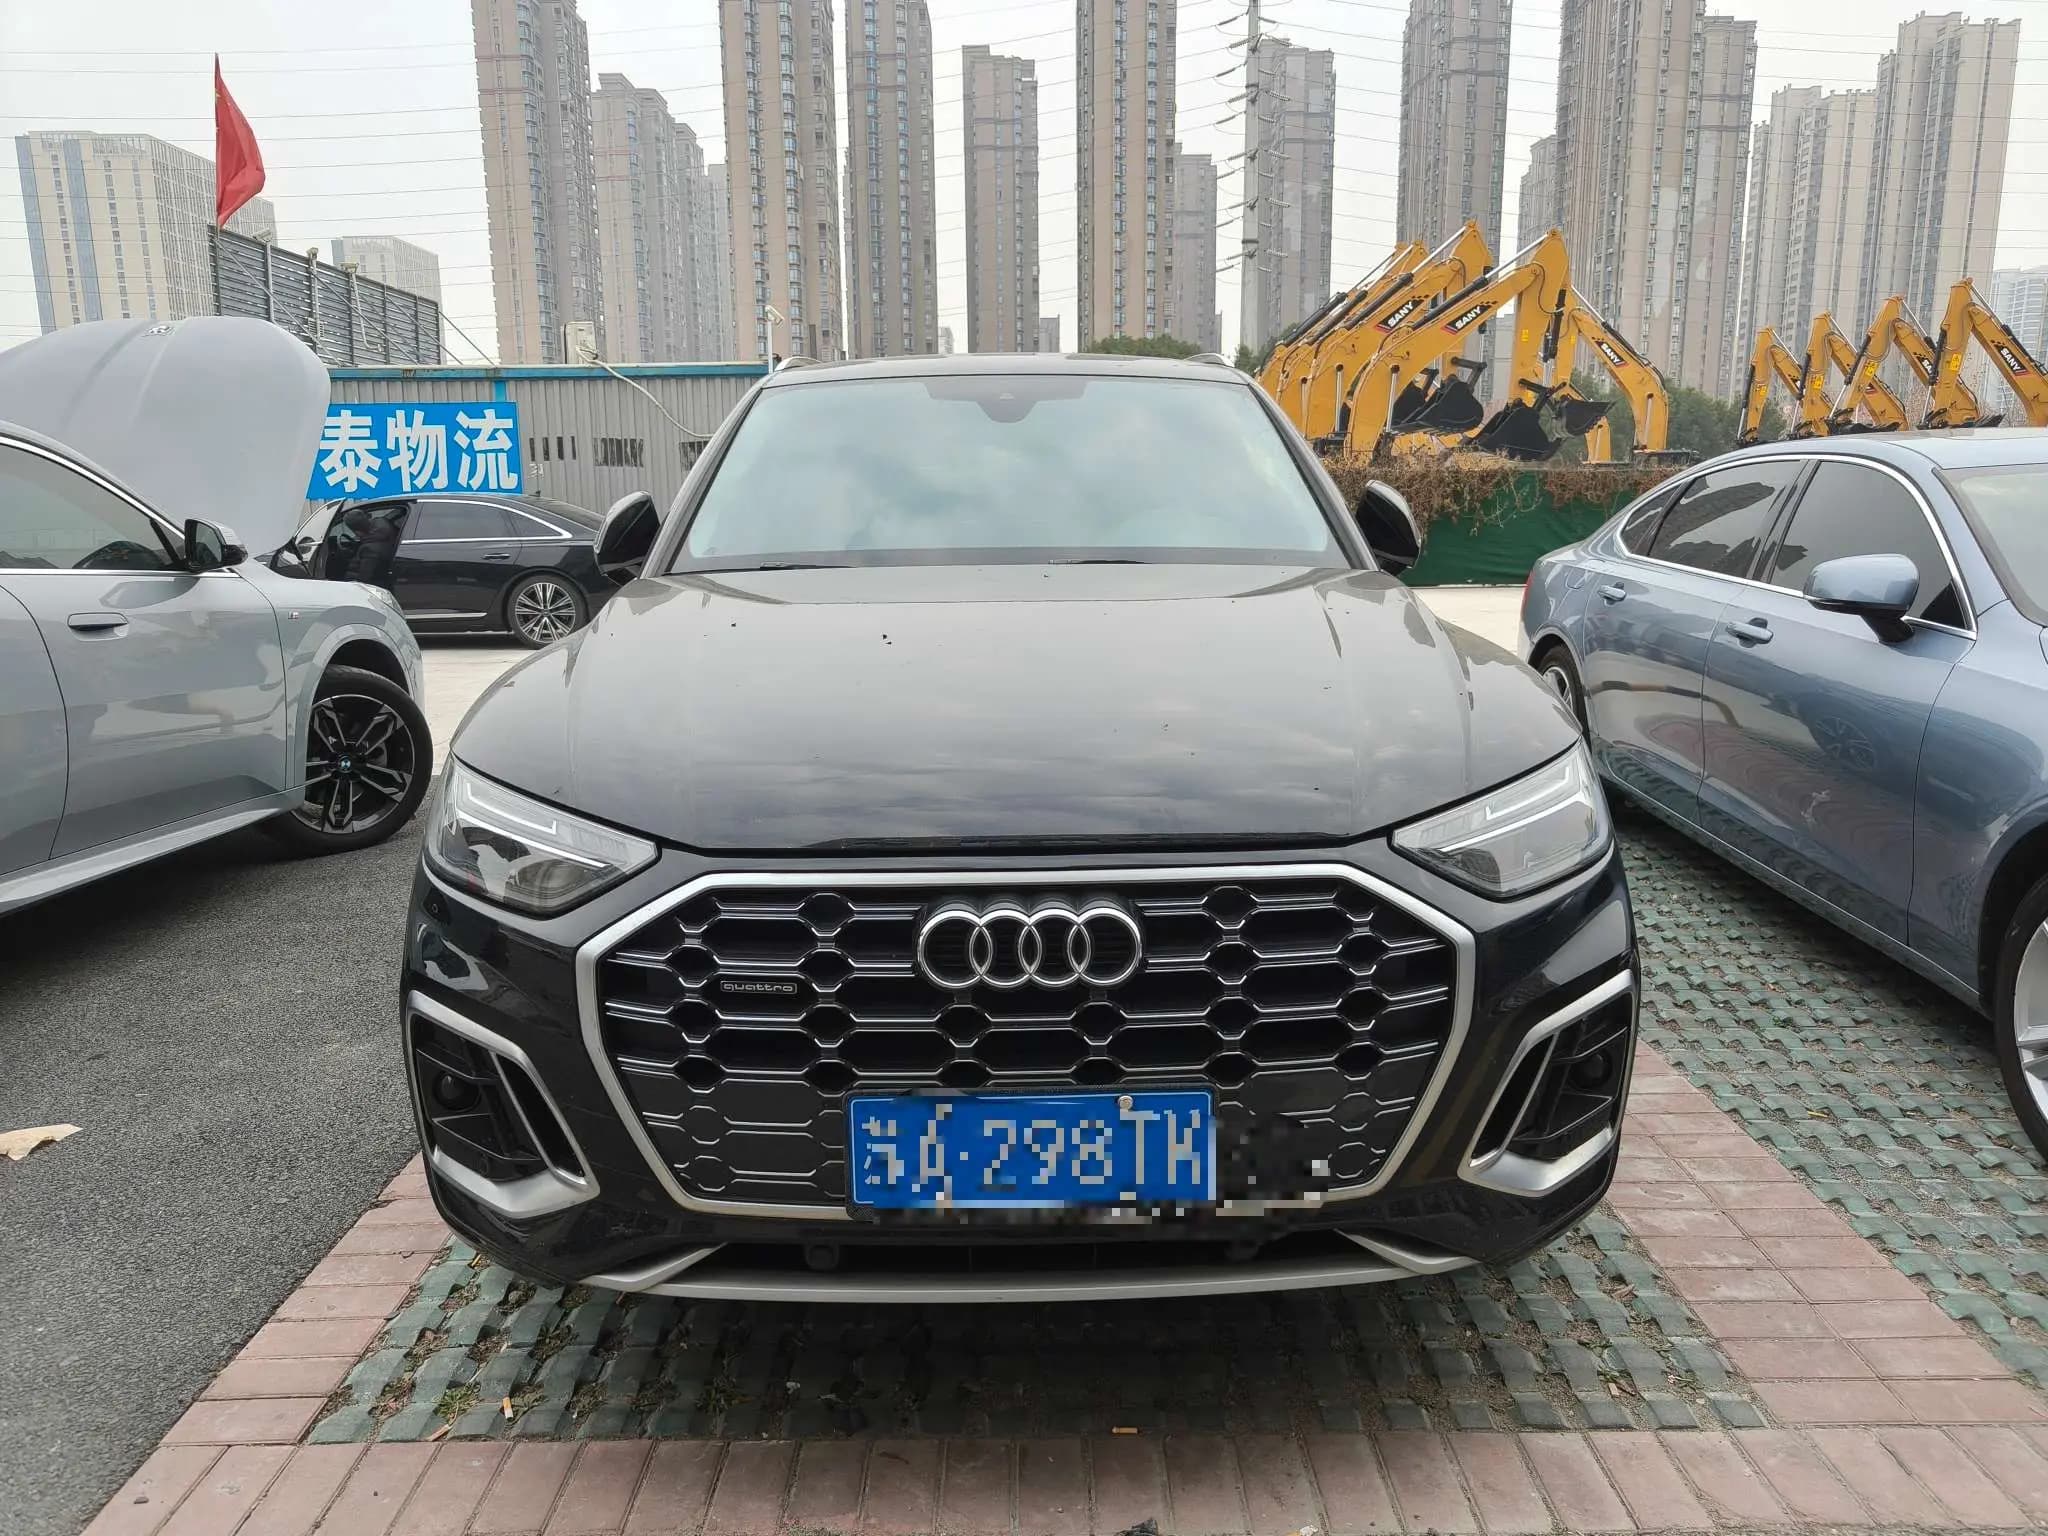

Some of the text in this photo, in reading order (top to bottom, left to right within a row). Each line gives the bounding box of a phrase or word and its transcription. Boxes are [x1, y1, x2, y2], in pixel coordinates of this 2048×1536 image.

[1387, 301, 1414, 327] SANY
[1455, 305, 1481, 330] SANY
[1600, 343, 1621, 363] SANY
[2000, 347, 2021, 371] SANY
[319, 408, 519, 492] 泰物流
[722, 983, 793, 992] quattro
